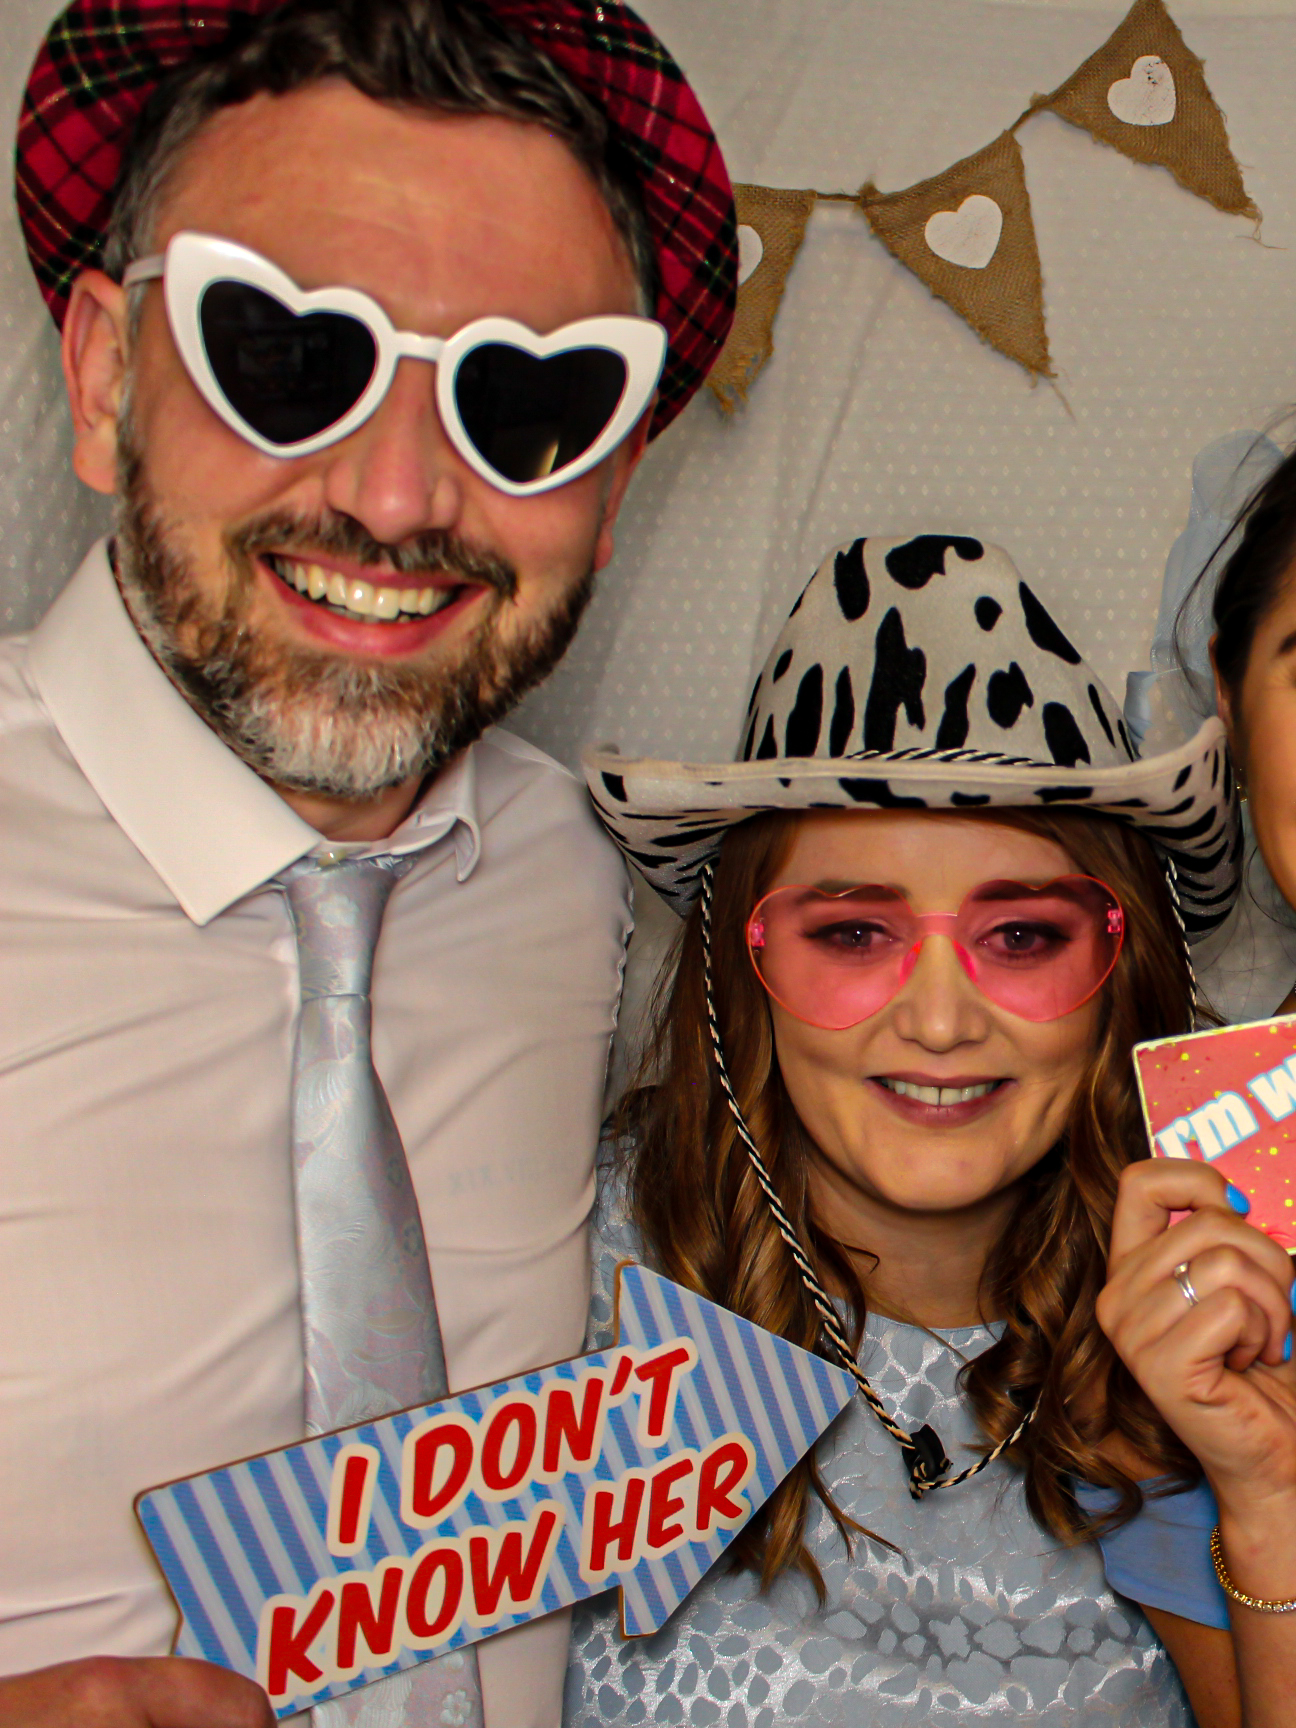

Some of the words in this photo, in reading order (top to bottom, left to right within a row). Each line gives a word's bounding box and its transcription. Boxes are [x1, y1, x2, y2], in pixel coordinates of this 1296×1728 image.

[1155, 1091, 1260, 1162] I'm
[334, 1450, 373, 1550] I
[410, 1345, 692, 1520] DON'T
[265, 1508, 558, 1698] KNOW
[587, 1440, 750, 1574] HER
